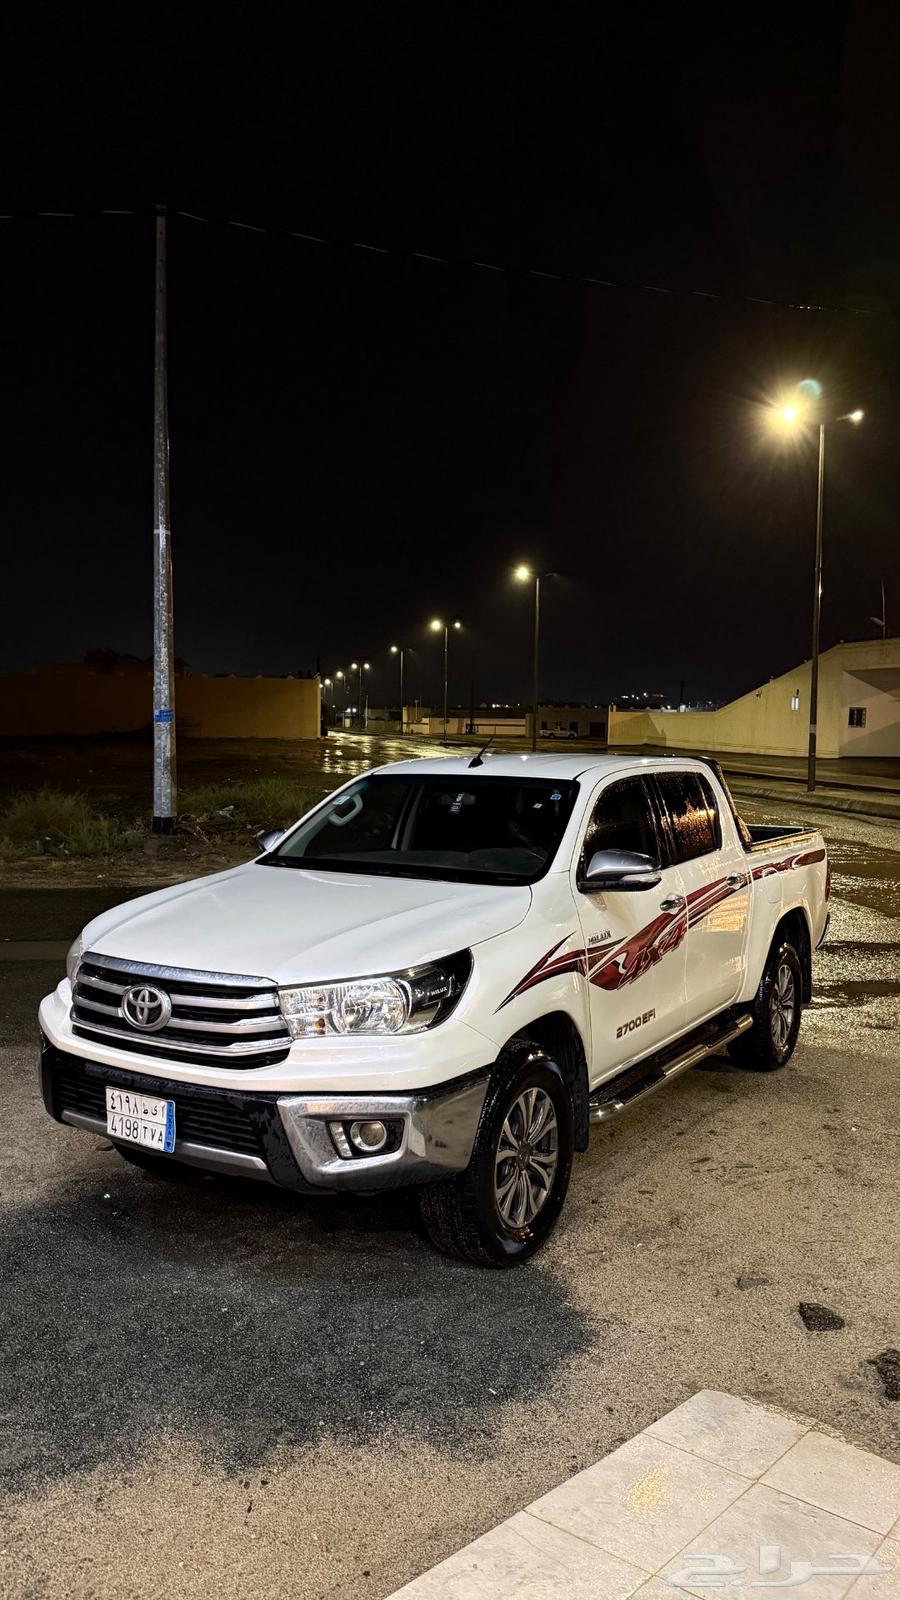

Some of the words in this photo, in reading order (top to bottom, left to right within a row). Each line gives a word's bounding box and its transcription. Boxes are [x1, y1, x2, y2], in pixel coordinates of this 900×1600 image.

[616, 1015, 642, 1039] 2700
[642, 1008, 656, 1024] EFI
[110, 1092, 139, 1115] ٤١٩٨
[111, 1115, 139, 1139] 4198
